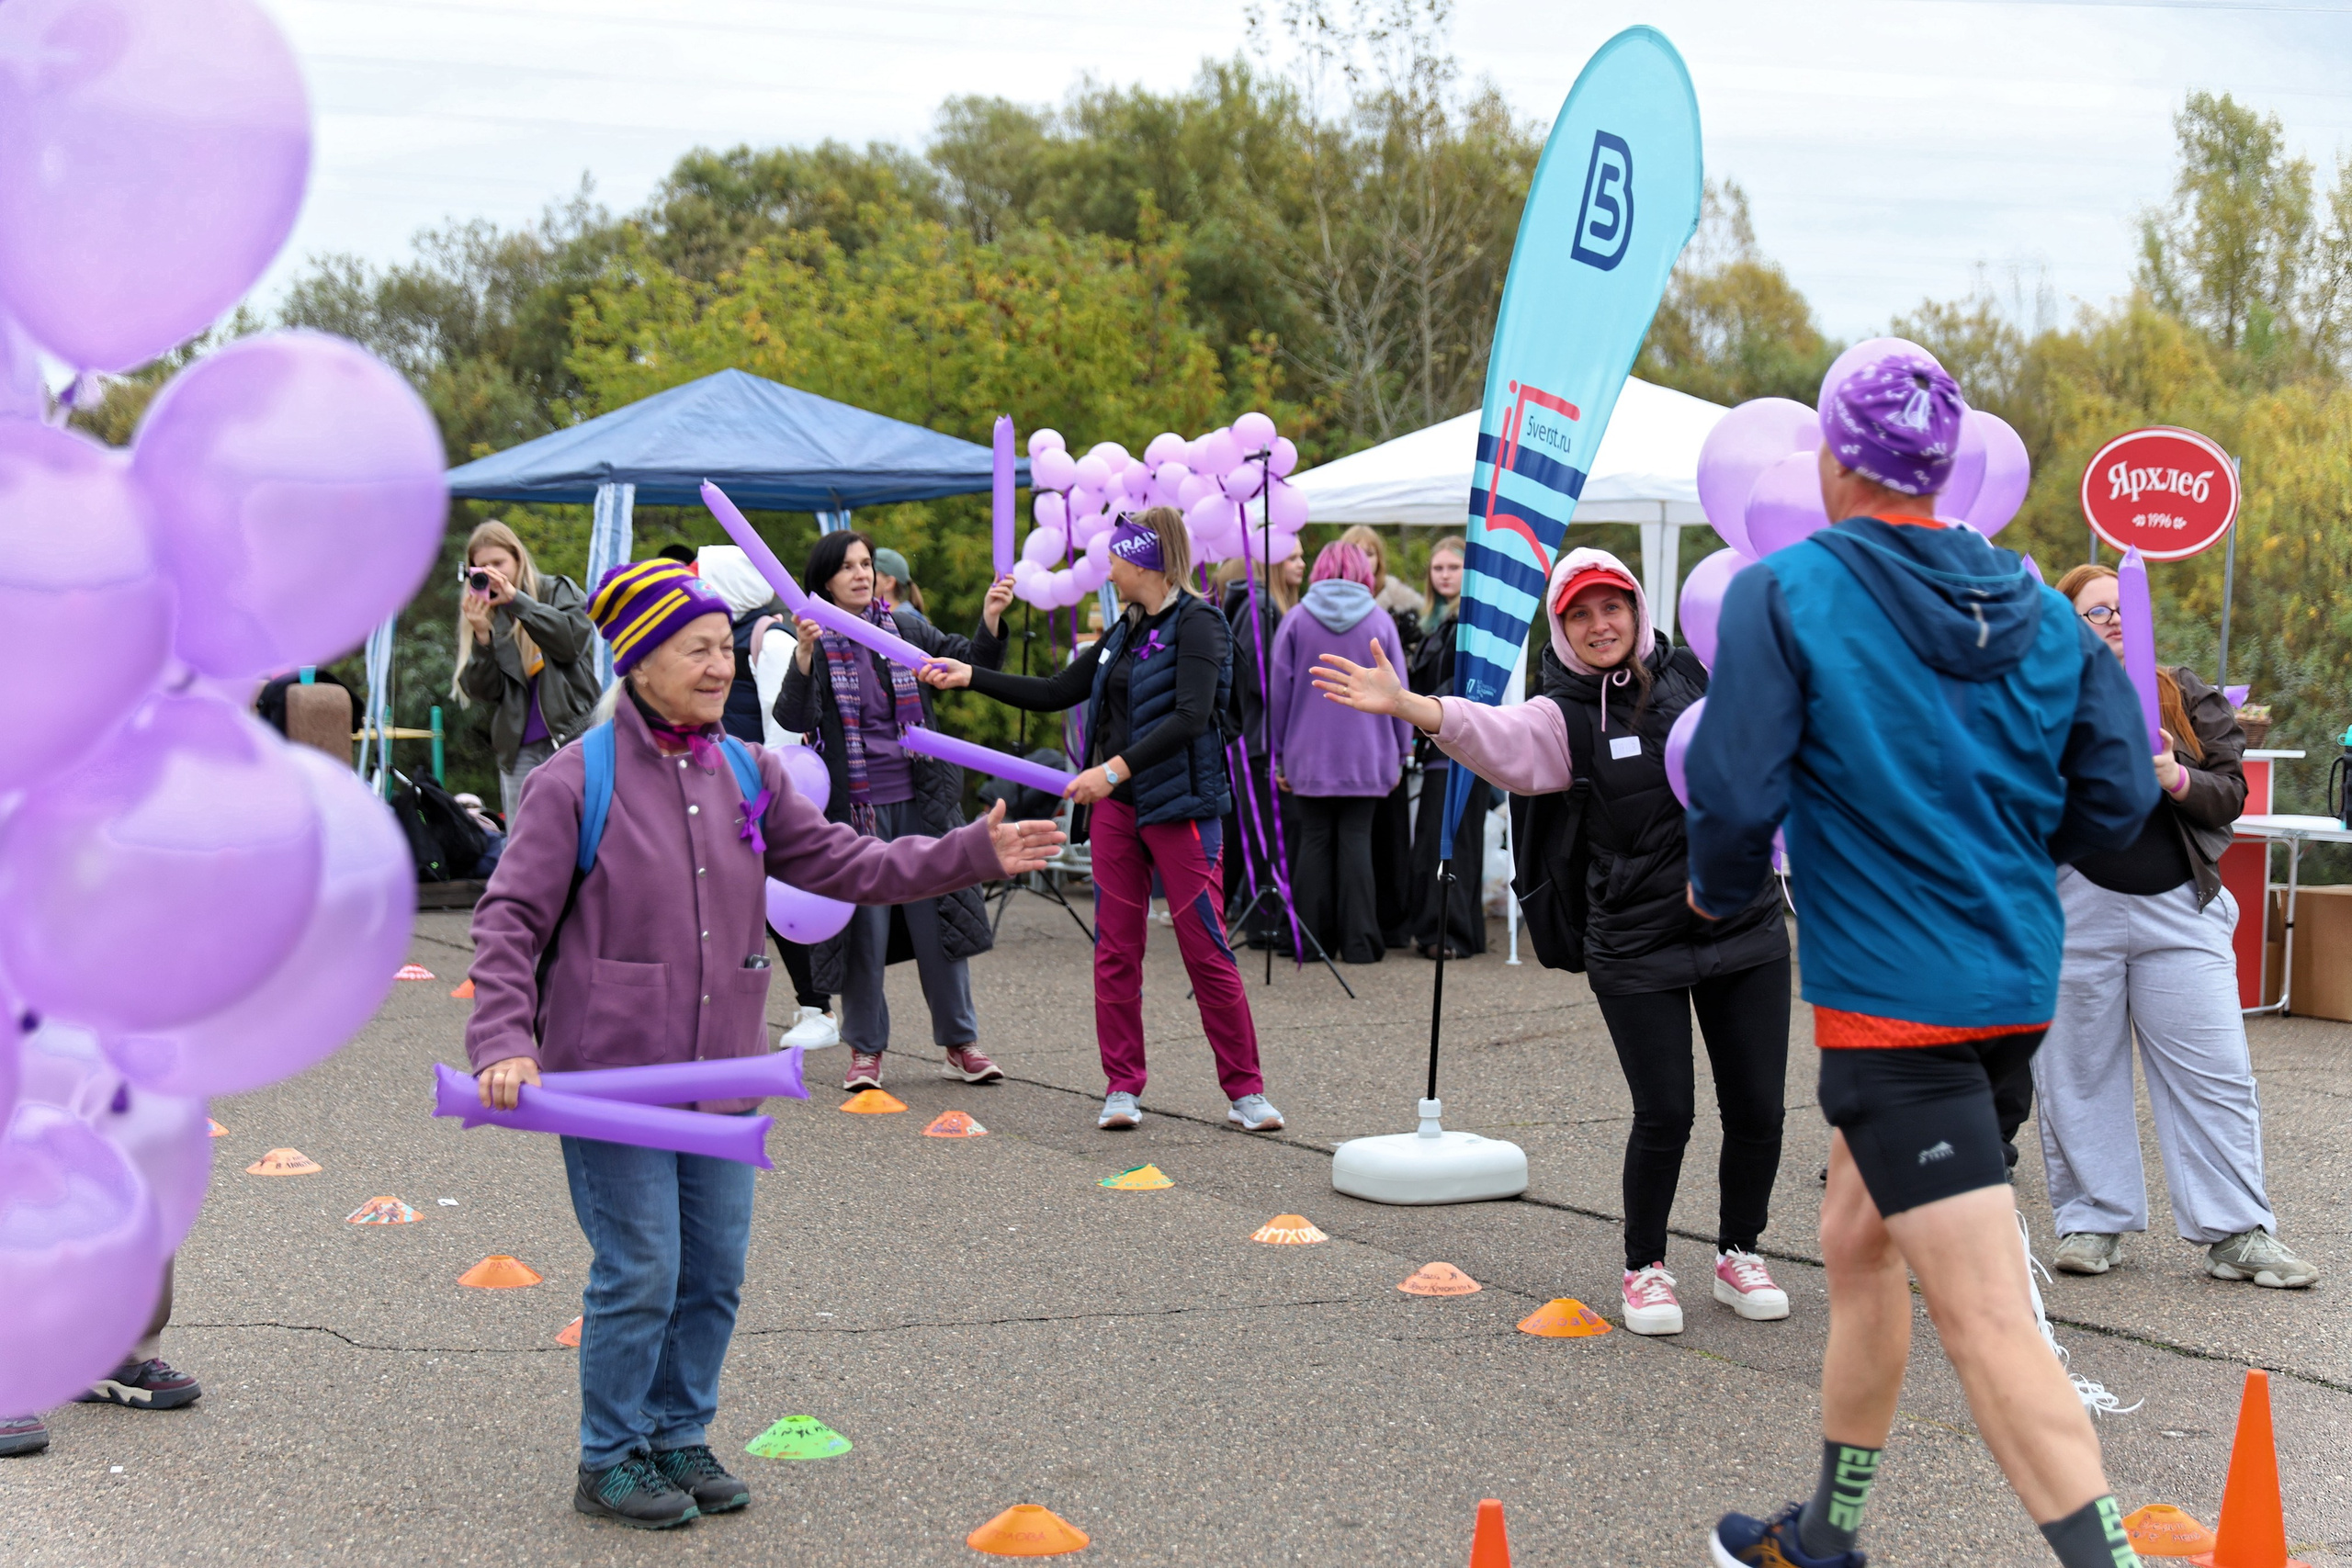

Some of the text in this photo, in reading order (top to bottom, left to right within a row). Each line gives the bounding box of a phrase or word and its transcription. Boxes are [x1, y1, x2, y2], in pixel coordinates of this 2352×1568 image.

[1526, 414, 1571, 454] 5verst.ru
[2108, 460, 2215, 503] Ярхлеб
[2147, 513, 2173, 529] 1996
